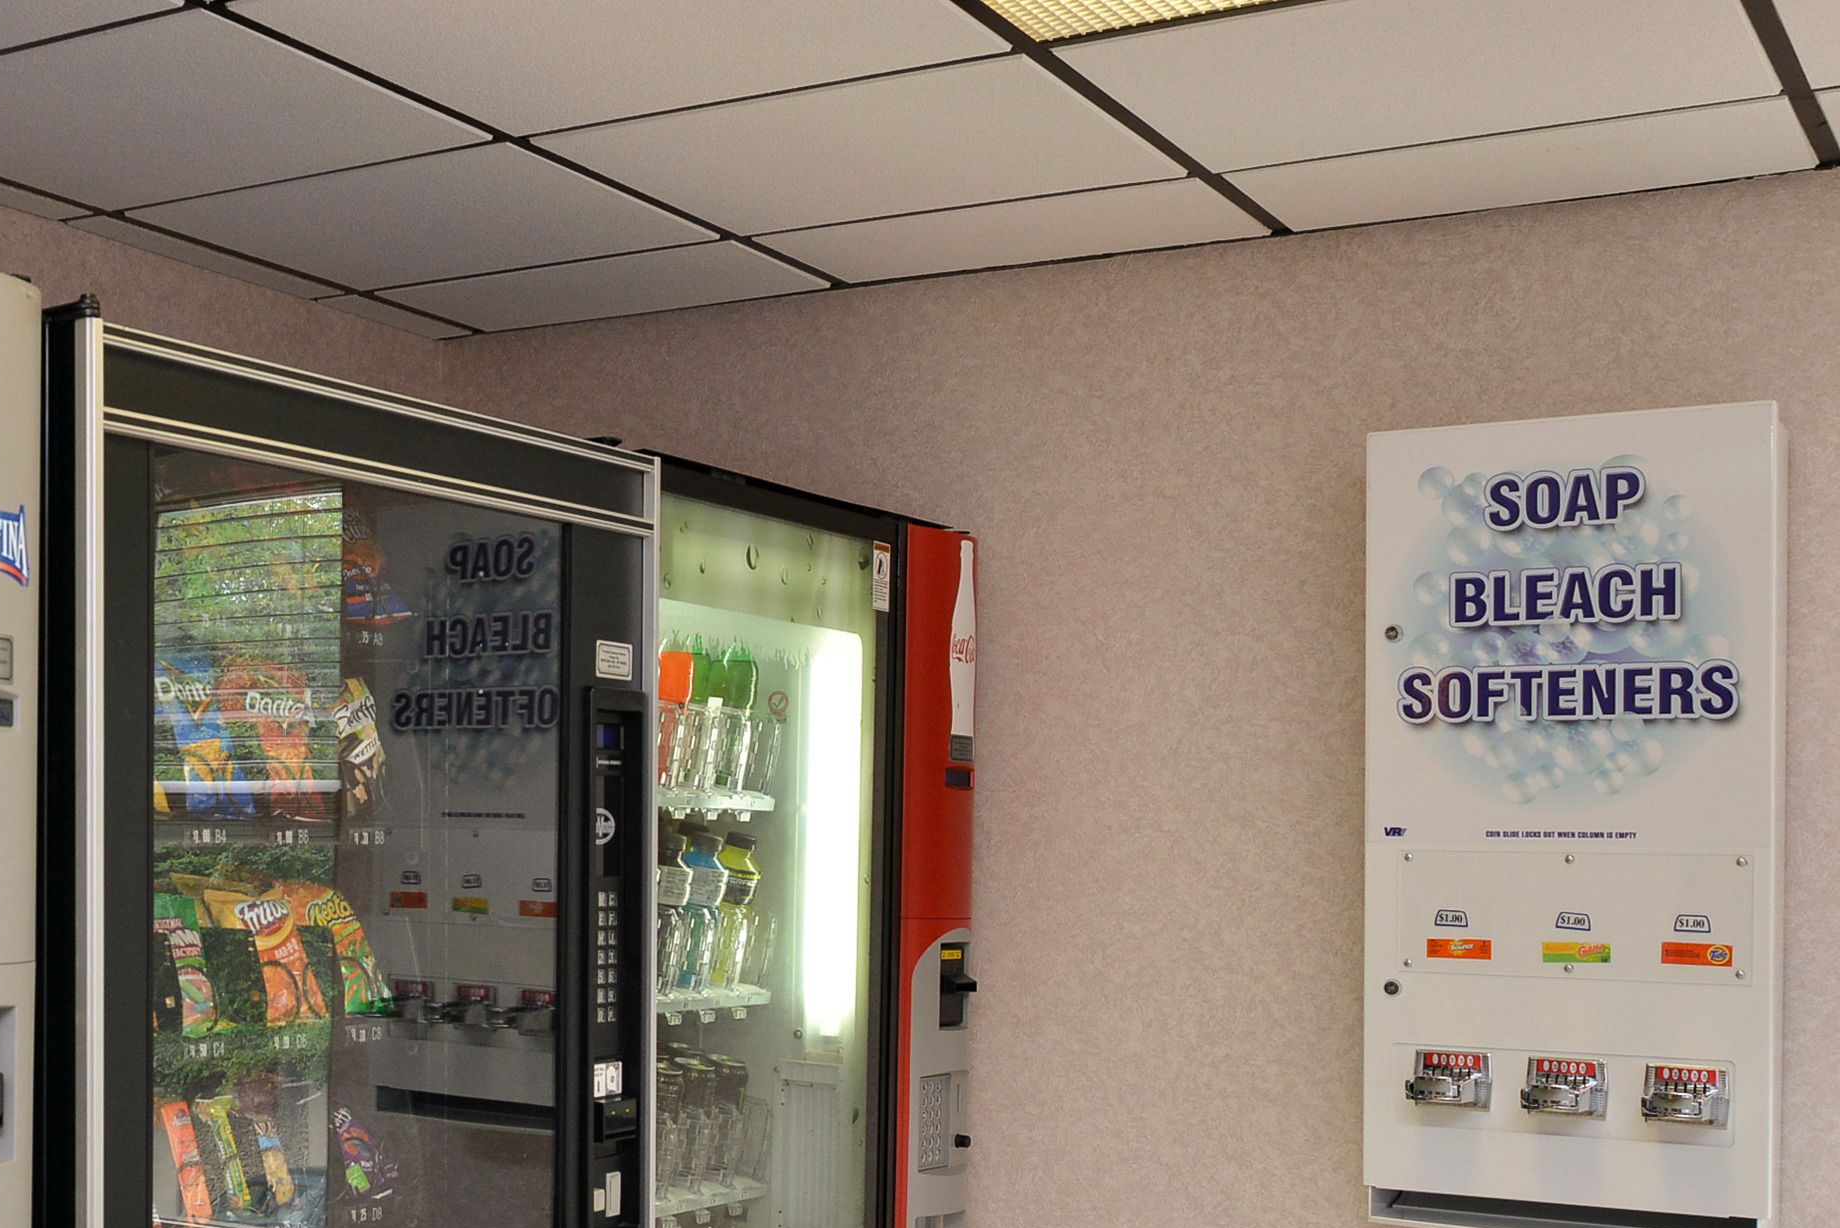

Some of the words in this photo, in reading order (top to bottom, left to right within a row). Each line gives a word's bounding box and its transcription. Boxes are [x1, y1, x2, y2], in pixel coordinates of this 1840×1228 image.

[1486, 470, 1644, 529] SOAP
[1452, 564, 1680, 626] BLEACH
[1400, 661, 1737, 722] SOFTENERS
[215, 829, 227, 843] B4
[1522, 830, 1541, 838] LOCKS
[1577, 831, 1605, 839] COLUMN
[1606, 831, 1613, 839] IS
[1615, 831, 1637, 839] EMPTY
[306, 891, 355, 927] Cheeto
[234, 899, 288, 934] Fritos
[1438, 913, 1463, 924] $1.00
[1560, 915, 1586, 926] $1.00
[1678, 918, 1705, 929] $1.00
[1710, 948, 1727, 960] Tide
